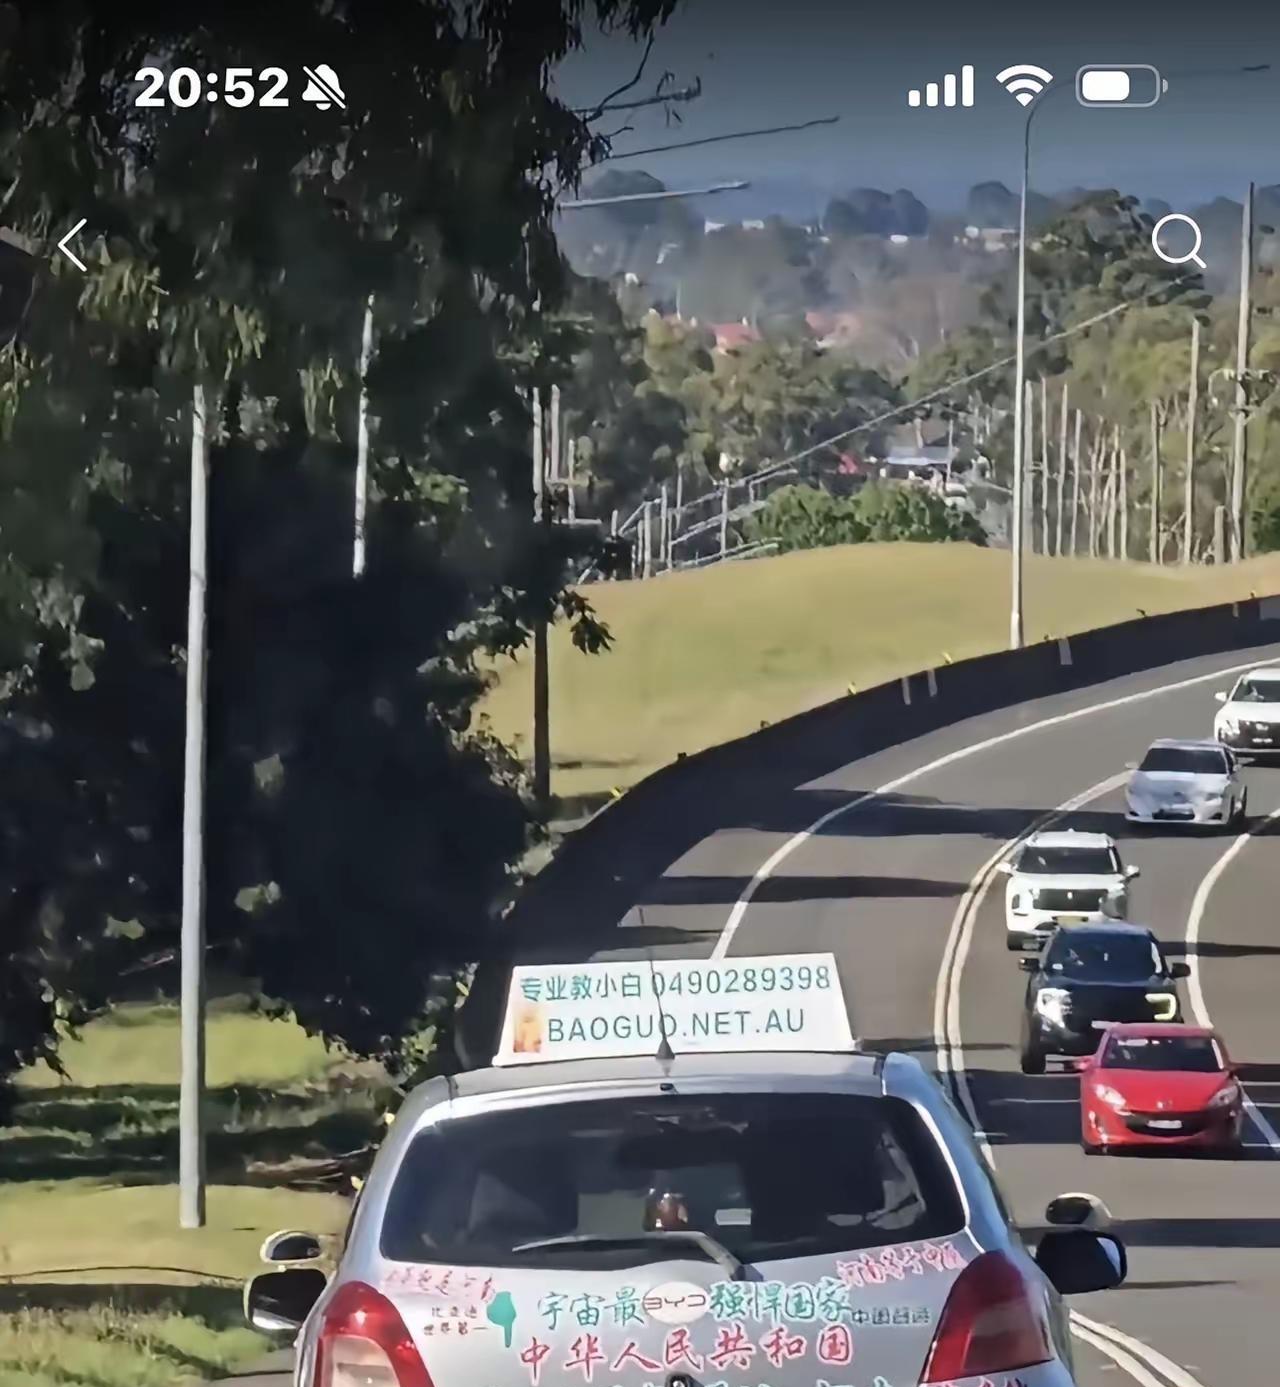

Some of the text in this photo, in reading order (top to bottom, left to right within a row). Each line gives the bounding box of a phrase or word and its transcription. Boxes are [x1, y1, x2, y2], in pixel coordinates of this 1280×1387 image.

[520, 966, 831, 1002] 专业教小白 0490289398
[548, 1008, 805, 1042] BAOGUO.NET.AU
[537, 1287, 645, 1330] 宇宙最
[519, 1325, 852, 1384] 中华人民共和国
